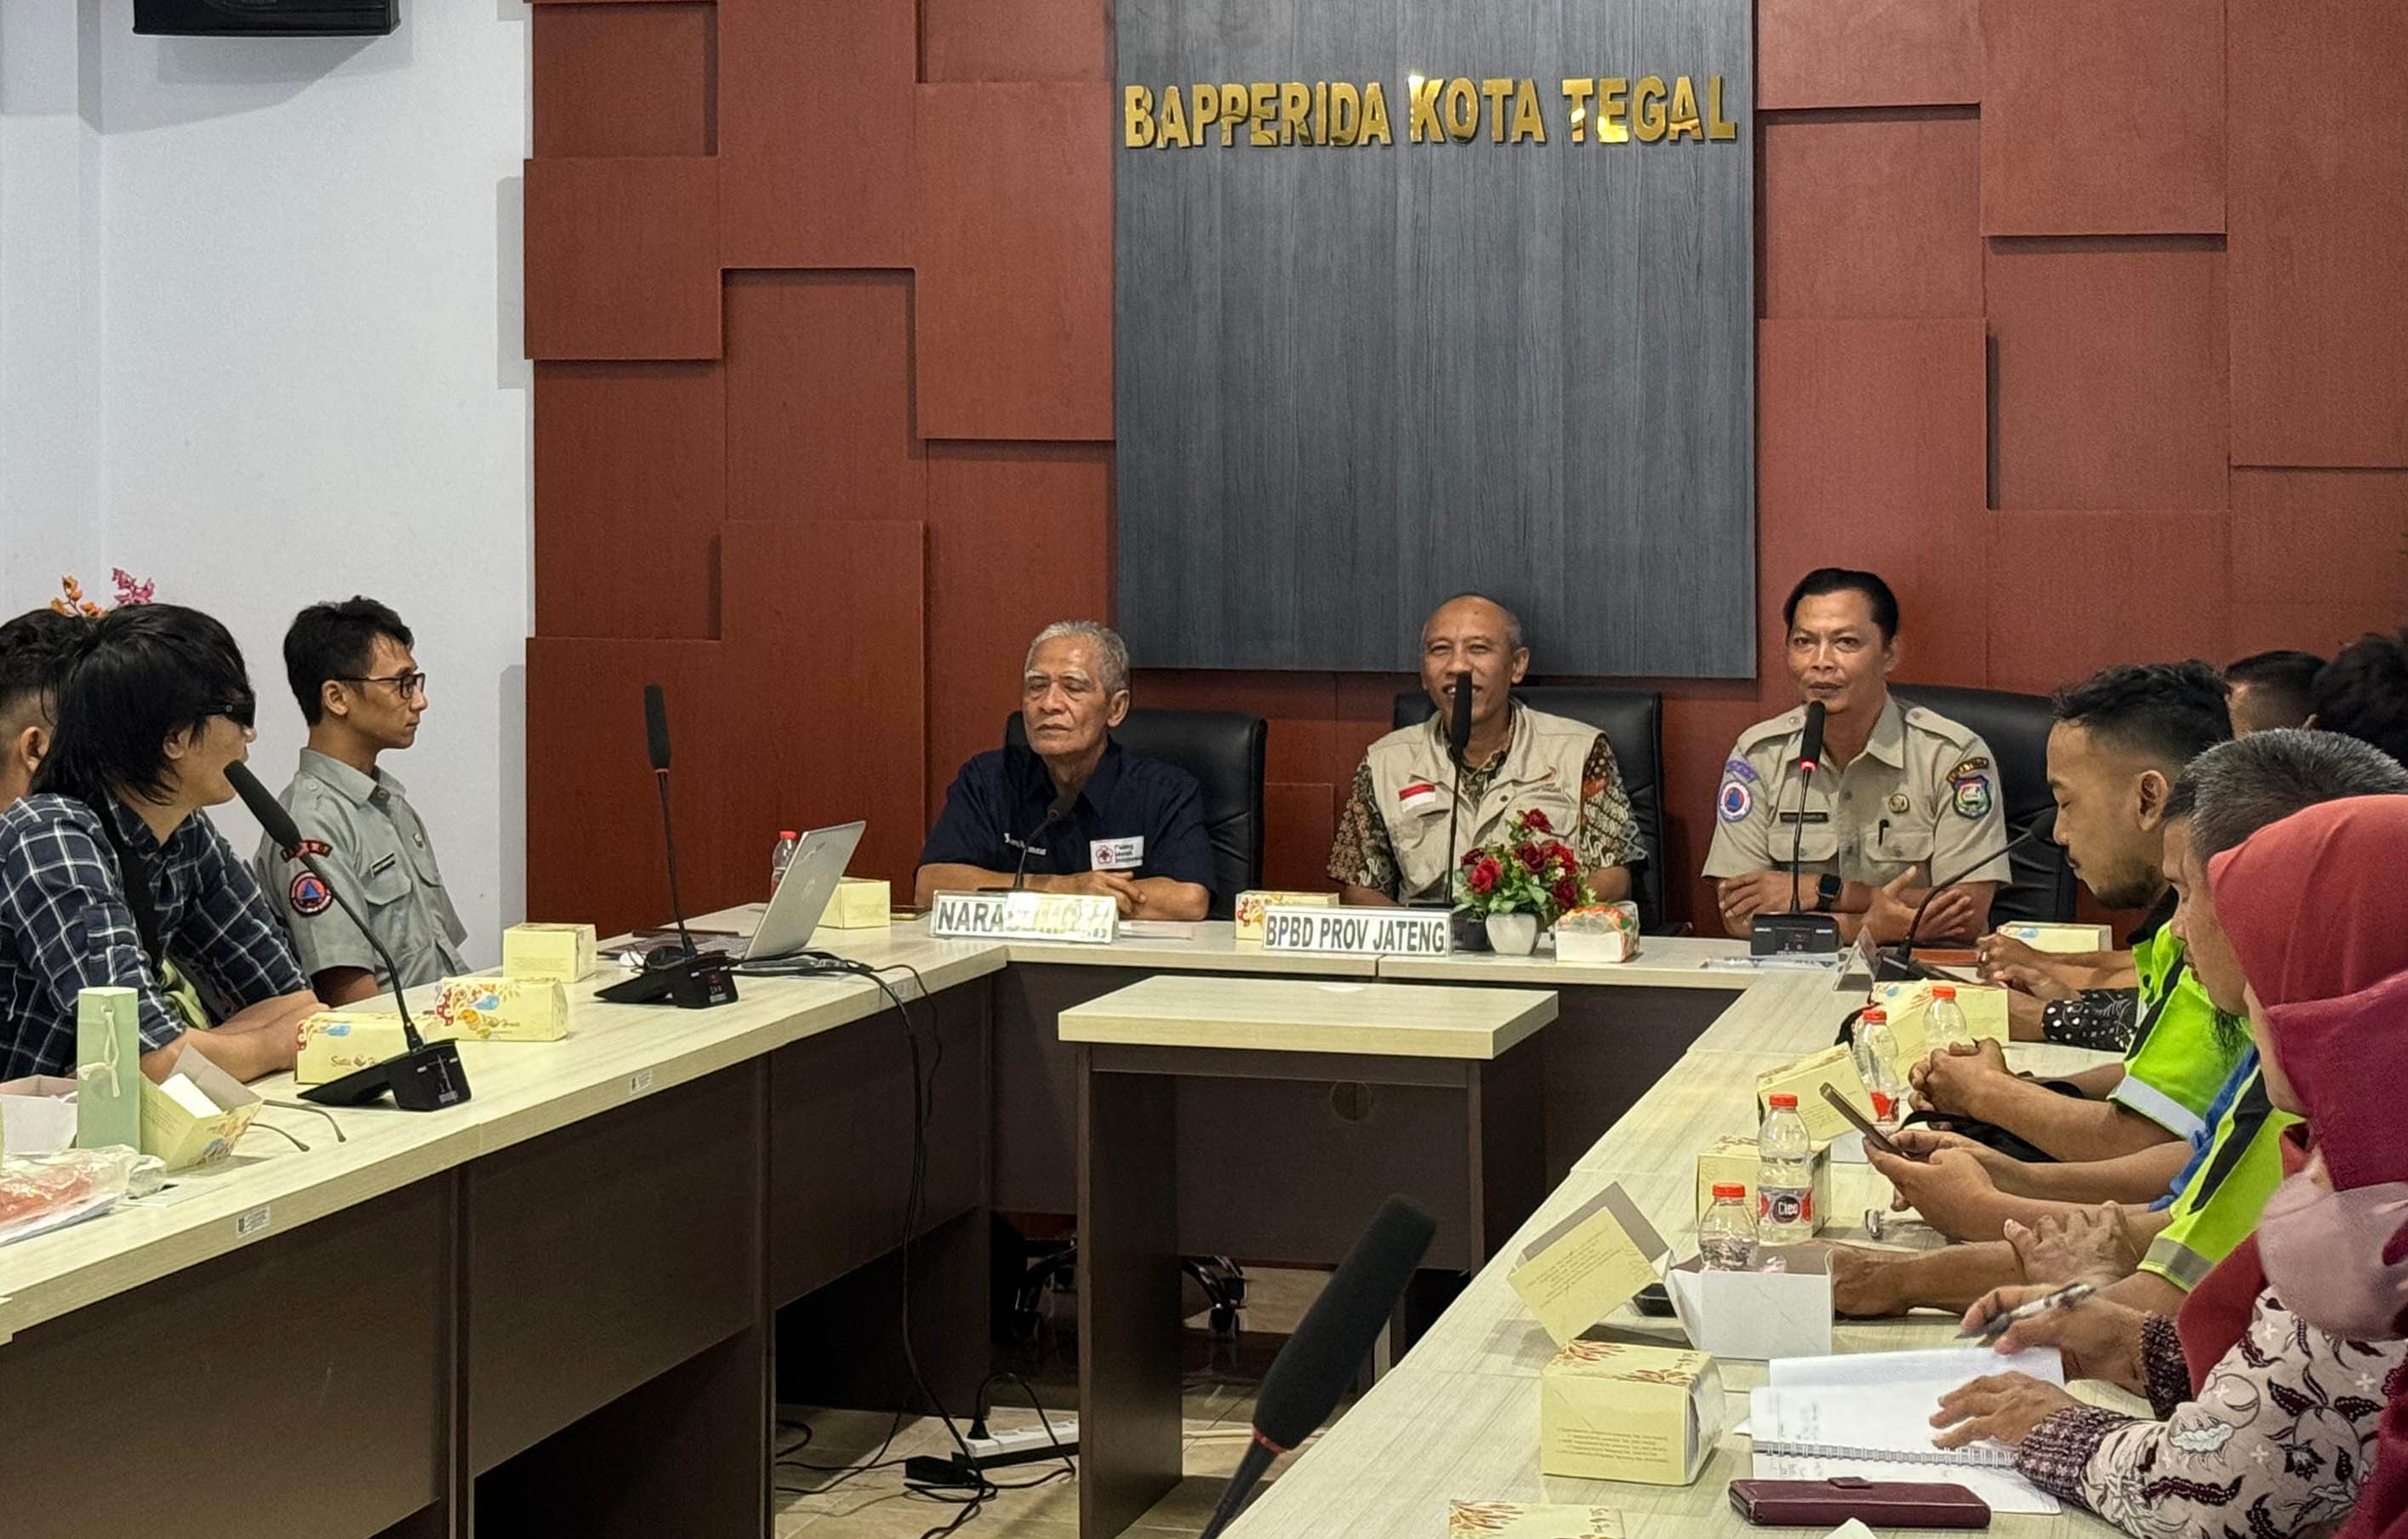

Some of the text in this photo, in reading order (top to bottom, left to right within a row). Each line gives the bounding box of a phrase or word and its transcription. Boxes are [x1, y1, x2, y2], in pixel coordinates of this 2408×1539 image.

[1124, 74, 1737, 148] BAPPERIDA KOTA TEGAL
[1265, 915, 1445, 953] BPBD PROV JATENG
